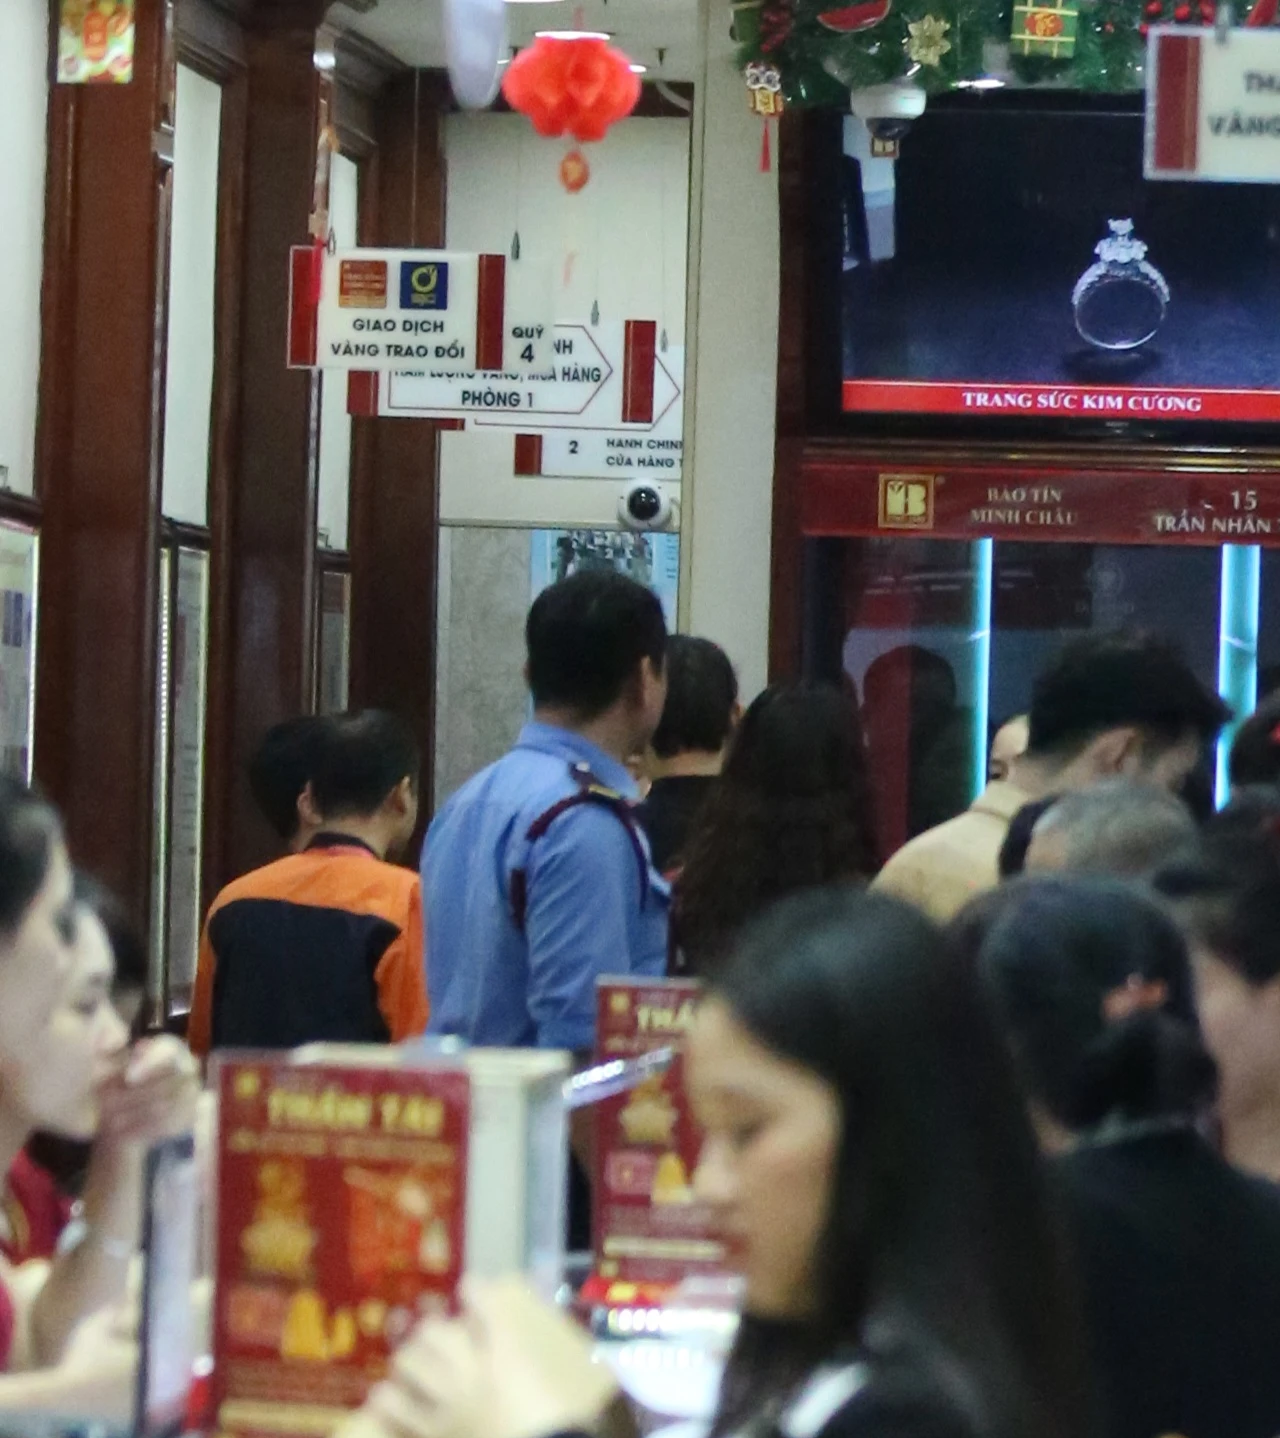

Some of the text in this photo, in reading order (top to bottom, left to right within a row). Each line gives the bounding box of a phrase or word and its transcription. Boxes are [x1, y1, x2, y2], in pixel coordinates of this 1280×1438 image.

[353, 318, 445, 336] GIAO DỊCH
[331, 341, 380, 357] VÀNG
[386, 345, 429, 358] TRAO
[520, 343, 534, 363] 4
[562, 363, 601, 382] HÀNG
[462, 387, 534, 407] PHÒNG 1
[962, 391, 1202, 412] TRANG SỨC KIM CƯƠNG
[568, 441, 579, 454] 2
[637, 455, 675, 468] HÀNG
[1231, 490, 1257, 510] 15
[970, 508, 1020, 524] MINH
[1155, 509, 1205, 533] TRẦN
[1212, 514, 1271, 534] NHÂN
